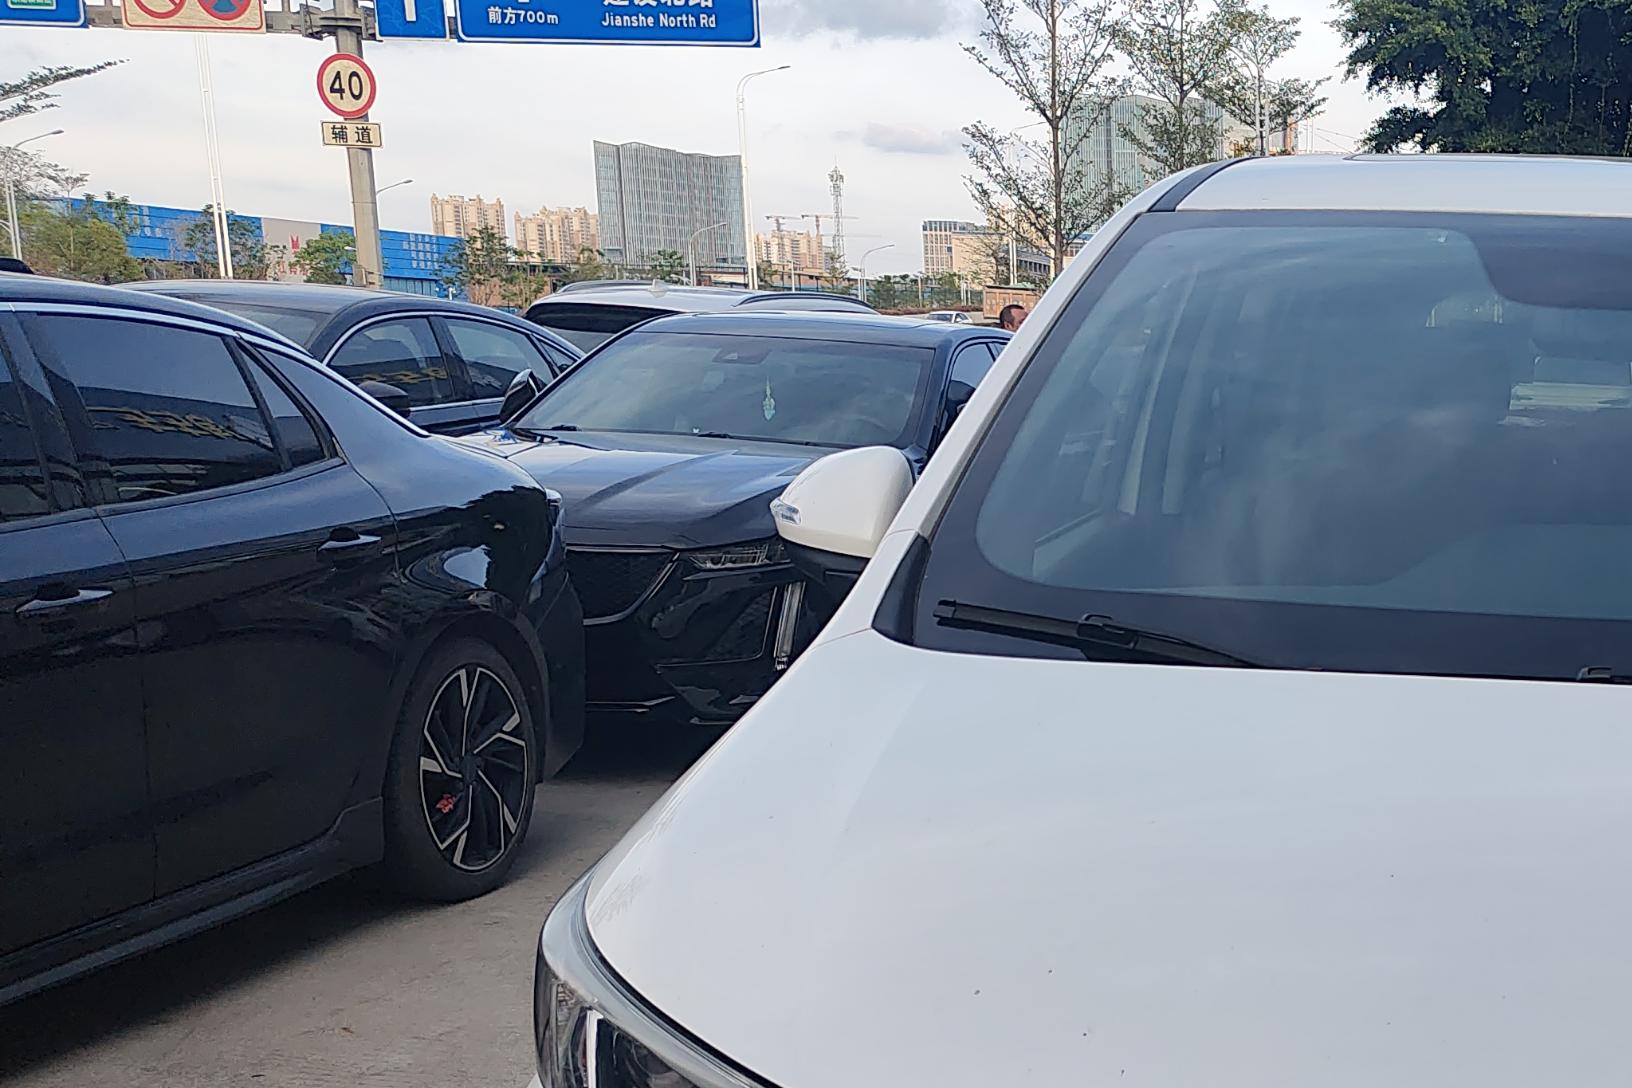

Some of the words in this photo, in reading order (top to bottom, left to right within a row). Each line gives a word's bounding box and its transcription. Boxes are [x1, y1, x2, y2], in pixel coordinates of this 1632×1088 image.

[602, 12, 654, 27] Jianshe
[659, 13, 697, 27] North
[699, 14, 717, 27] Rd
[330, 70, 363, 100] 40
